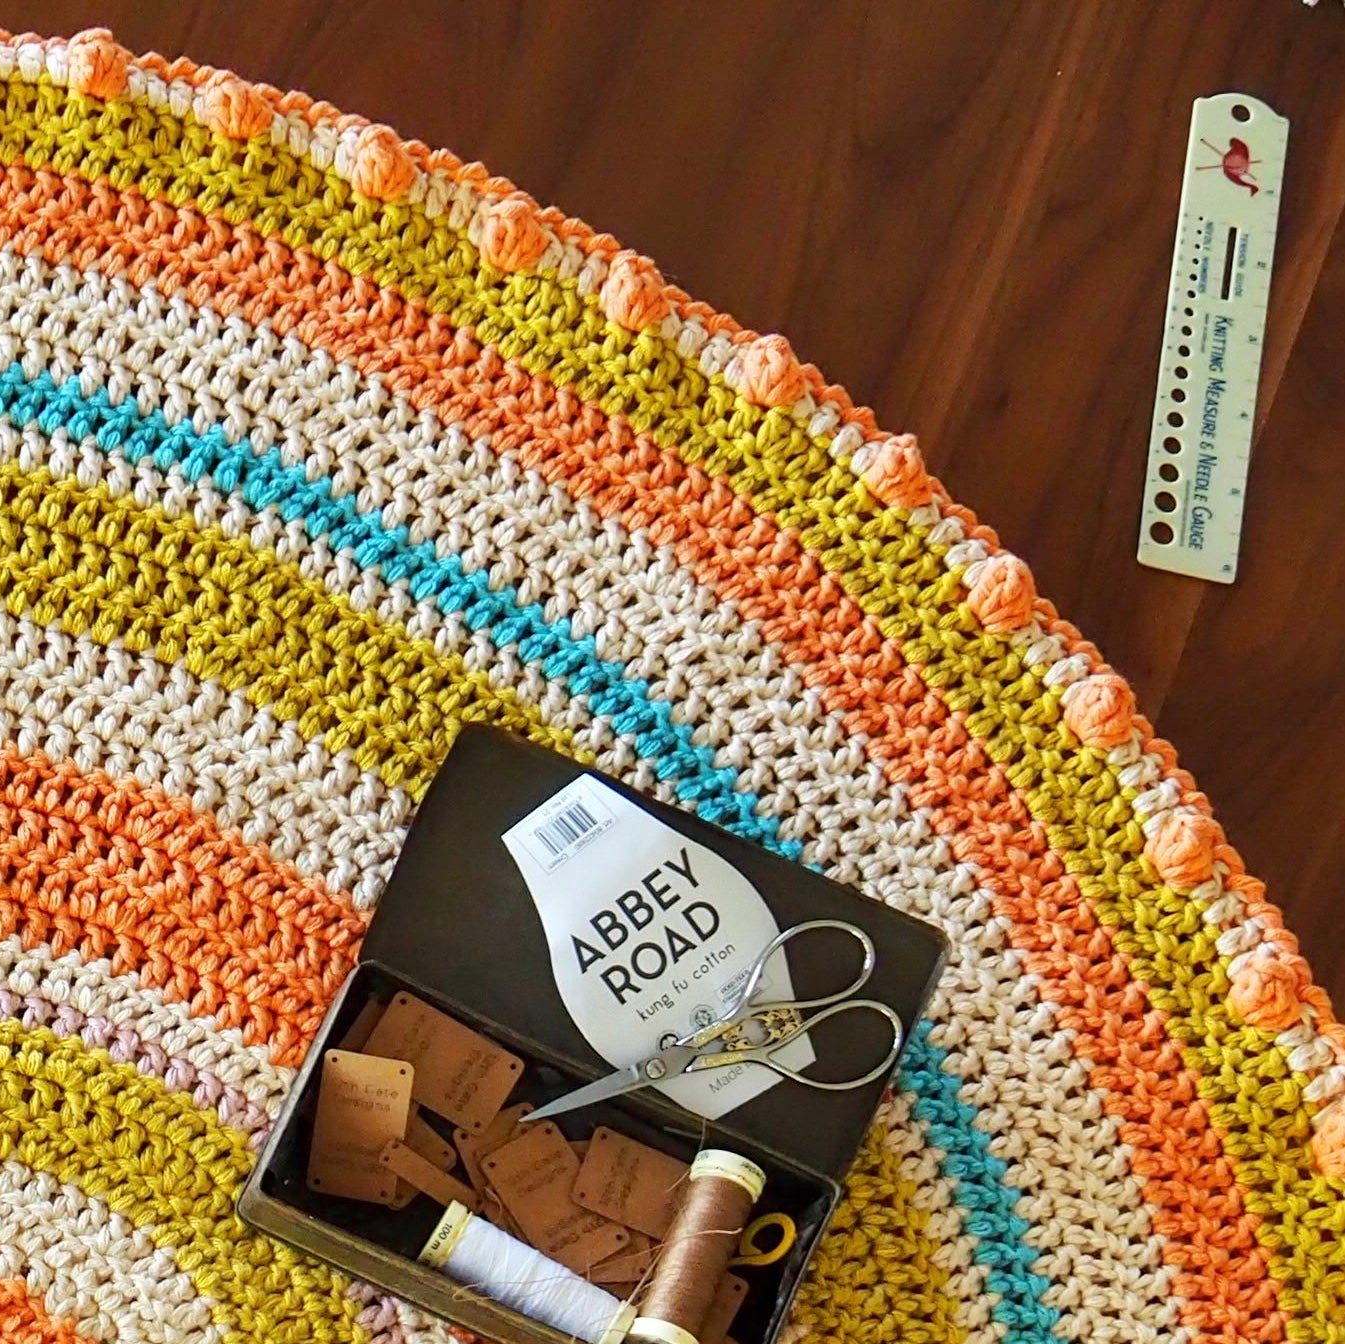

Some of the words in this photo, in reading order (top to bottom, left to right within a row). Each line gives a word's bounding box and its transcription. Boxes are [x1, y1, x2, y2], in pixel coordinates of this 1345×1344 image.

[1209, 315, 1234, 373] KNITTING
[1201, 376, 1227, 439] MEASURE
[1193, 453, 1218, 503] NEEDLE
[1189, 506, 1213, 550] GAUGE
[570, 847, 699, 974] ABBEY
[600, 901, 720, 1005] ROAD
[635, 994, 675, 1022] kung
[672, 980, 689, 994] fu
[692, 943, 737, 980] cotton
[708, 1066, 745, 1094] Made
[431, 1240, 441, 1250] m
[439, 1223, 453, 1240] 100
